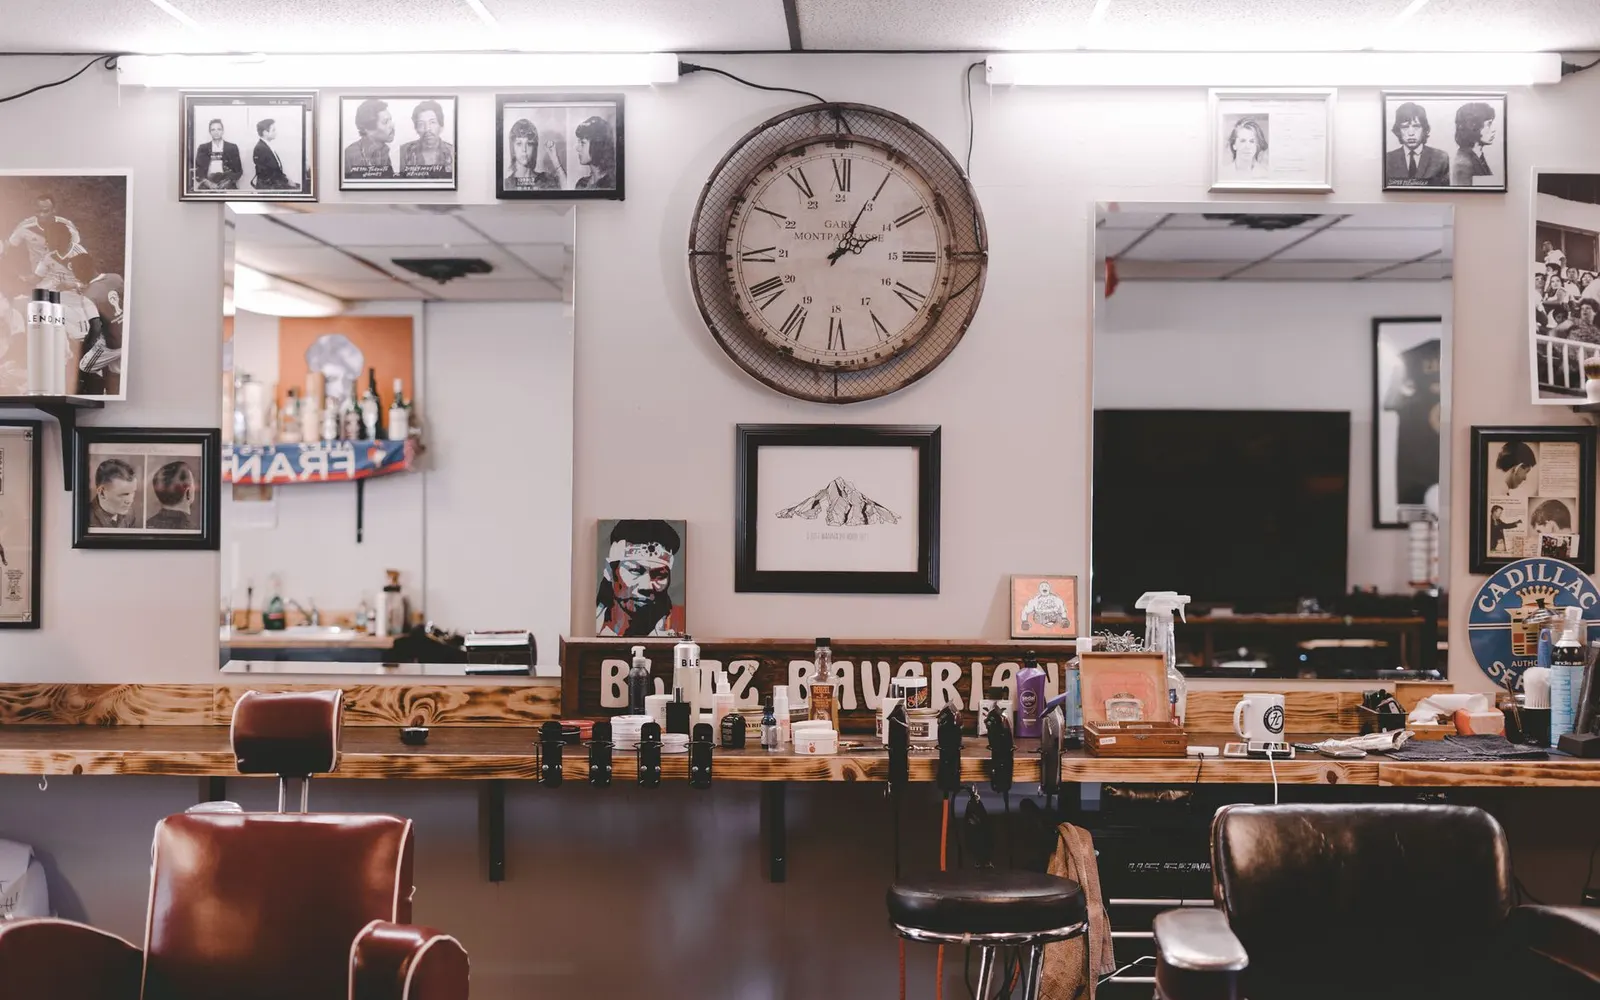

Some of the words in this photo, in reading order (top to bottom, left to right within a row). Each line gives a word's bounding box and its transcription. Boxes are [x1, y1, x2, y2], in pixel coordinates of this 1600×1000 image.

[807, 200, 819, 210] 23
[784, 221, 796, 230] 22
[881, 223, 892, 232] 14
[778, 249, 789, 258] 21
[888, 252, 899, 262] 15
[784, 275, 796, 284] 20
[880, 277, 892, 287] 16
[802, 296, 813, 305] 19
[860, 297, 872, 306] 17
[831, 305, 842, 314] 18
[1478, 563, 1598, 613] CADILLAC
